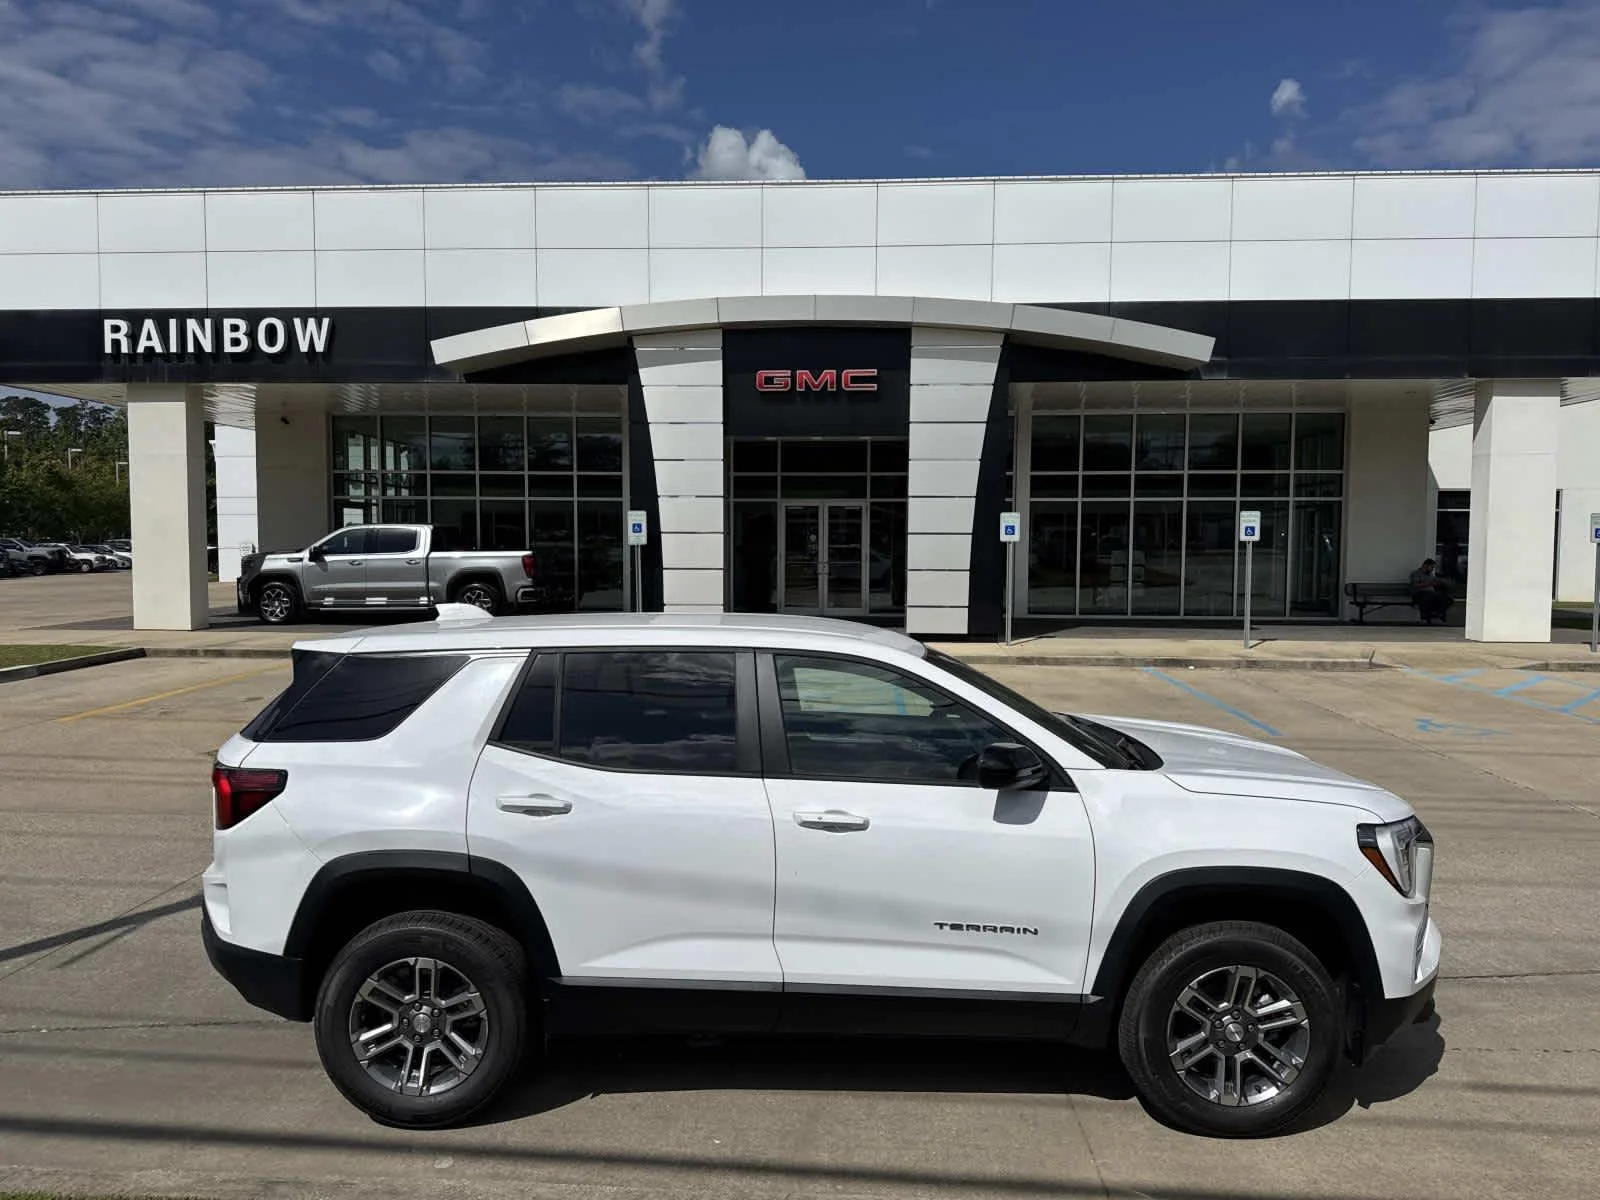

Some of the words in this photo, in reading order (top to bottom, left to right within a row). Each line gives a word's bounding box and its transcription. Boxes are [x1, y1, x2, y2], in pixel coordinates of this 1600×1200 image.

[103, 317, 332, 355] RAINBOW
[756, 369, 878, 391] GMC
[934, 922, 1039, 935] TERRAIN
